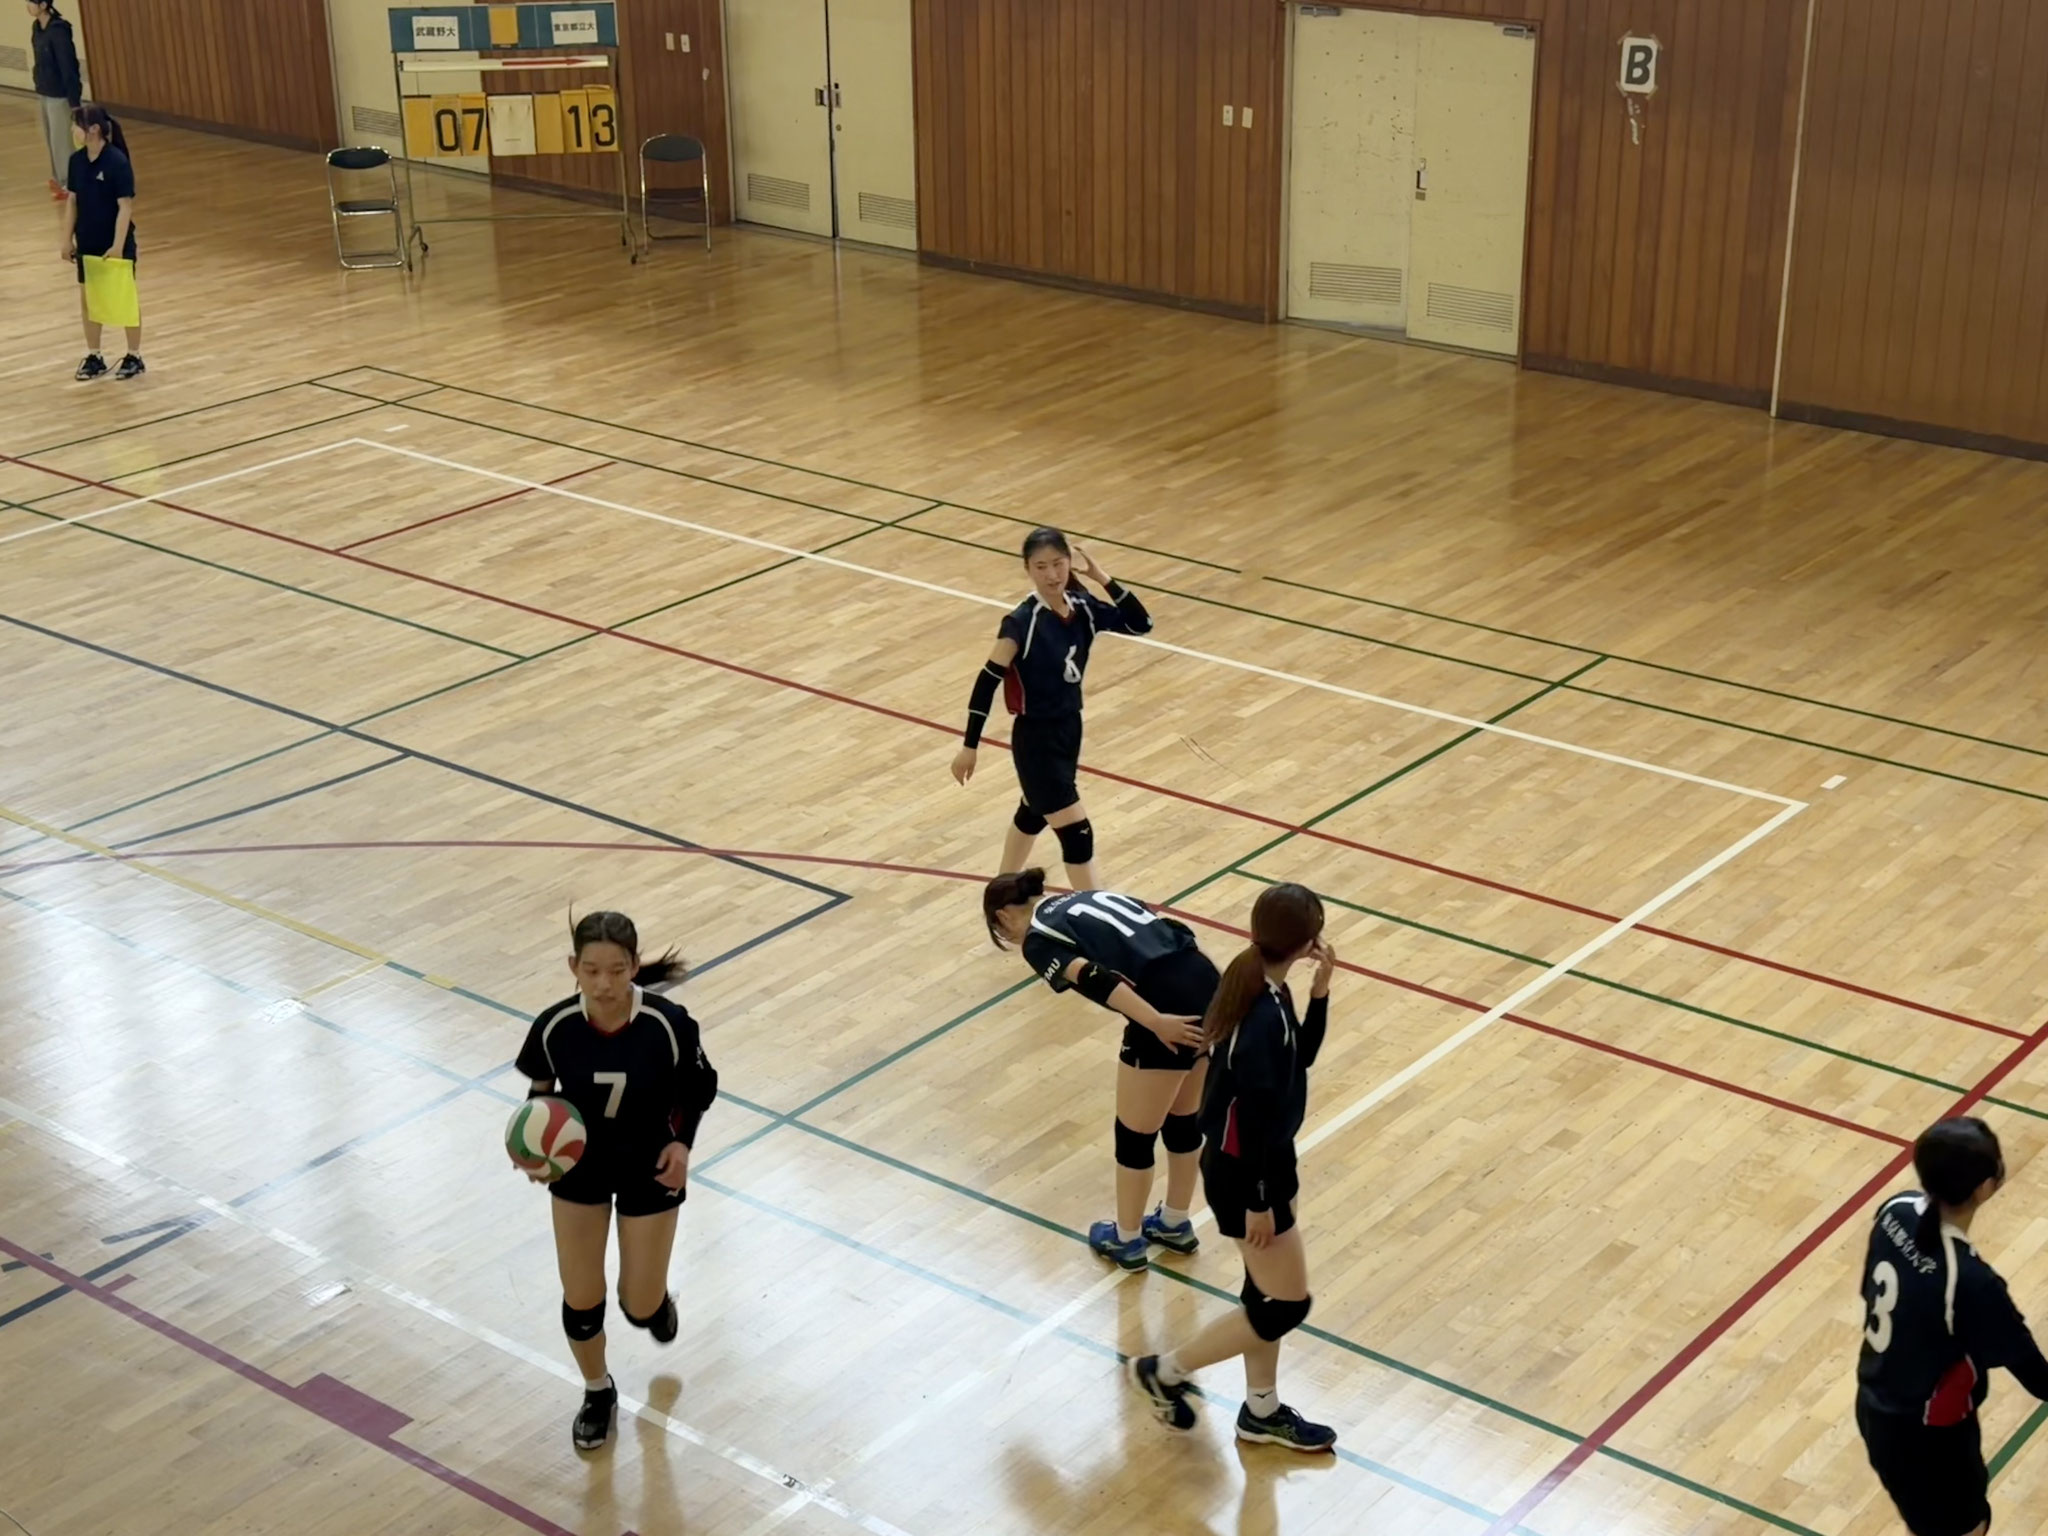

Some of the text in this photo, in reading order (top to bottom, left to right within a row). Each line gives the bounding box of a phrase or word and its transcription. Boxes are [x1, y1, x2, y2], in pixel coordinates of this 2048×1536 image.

[1625, 45, 1653, 85] B
[435, 107, 485, 152] 07
[566, 104, 615, 148] 13
[1063, 644, 1082, 683] 6
[1066, 891, 1158, 938] 10
[593, 1071, 627, 1119] 7
[1865, 1260, 1899, 1354] 3
